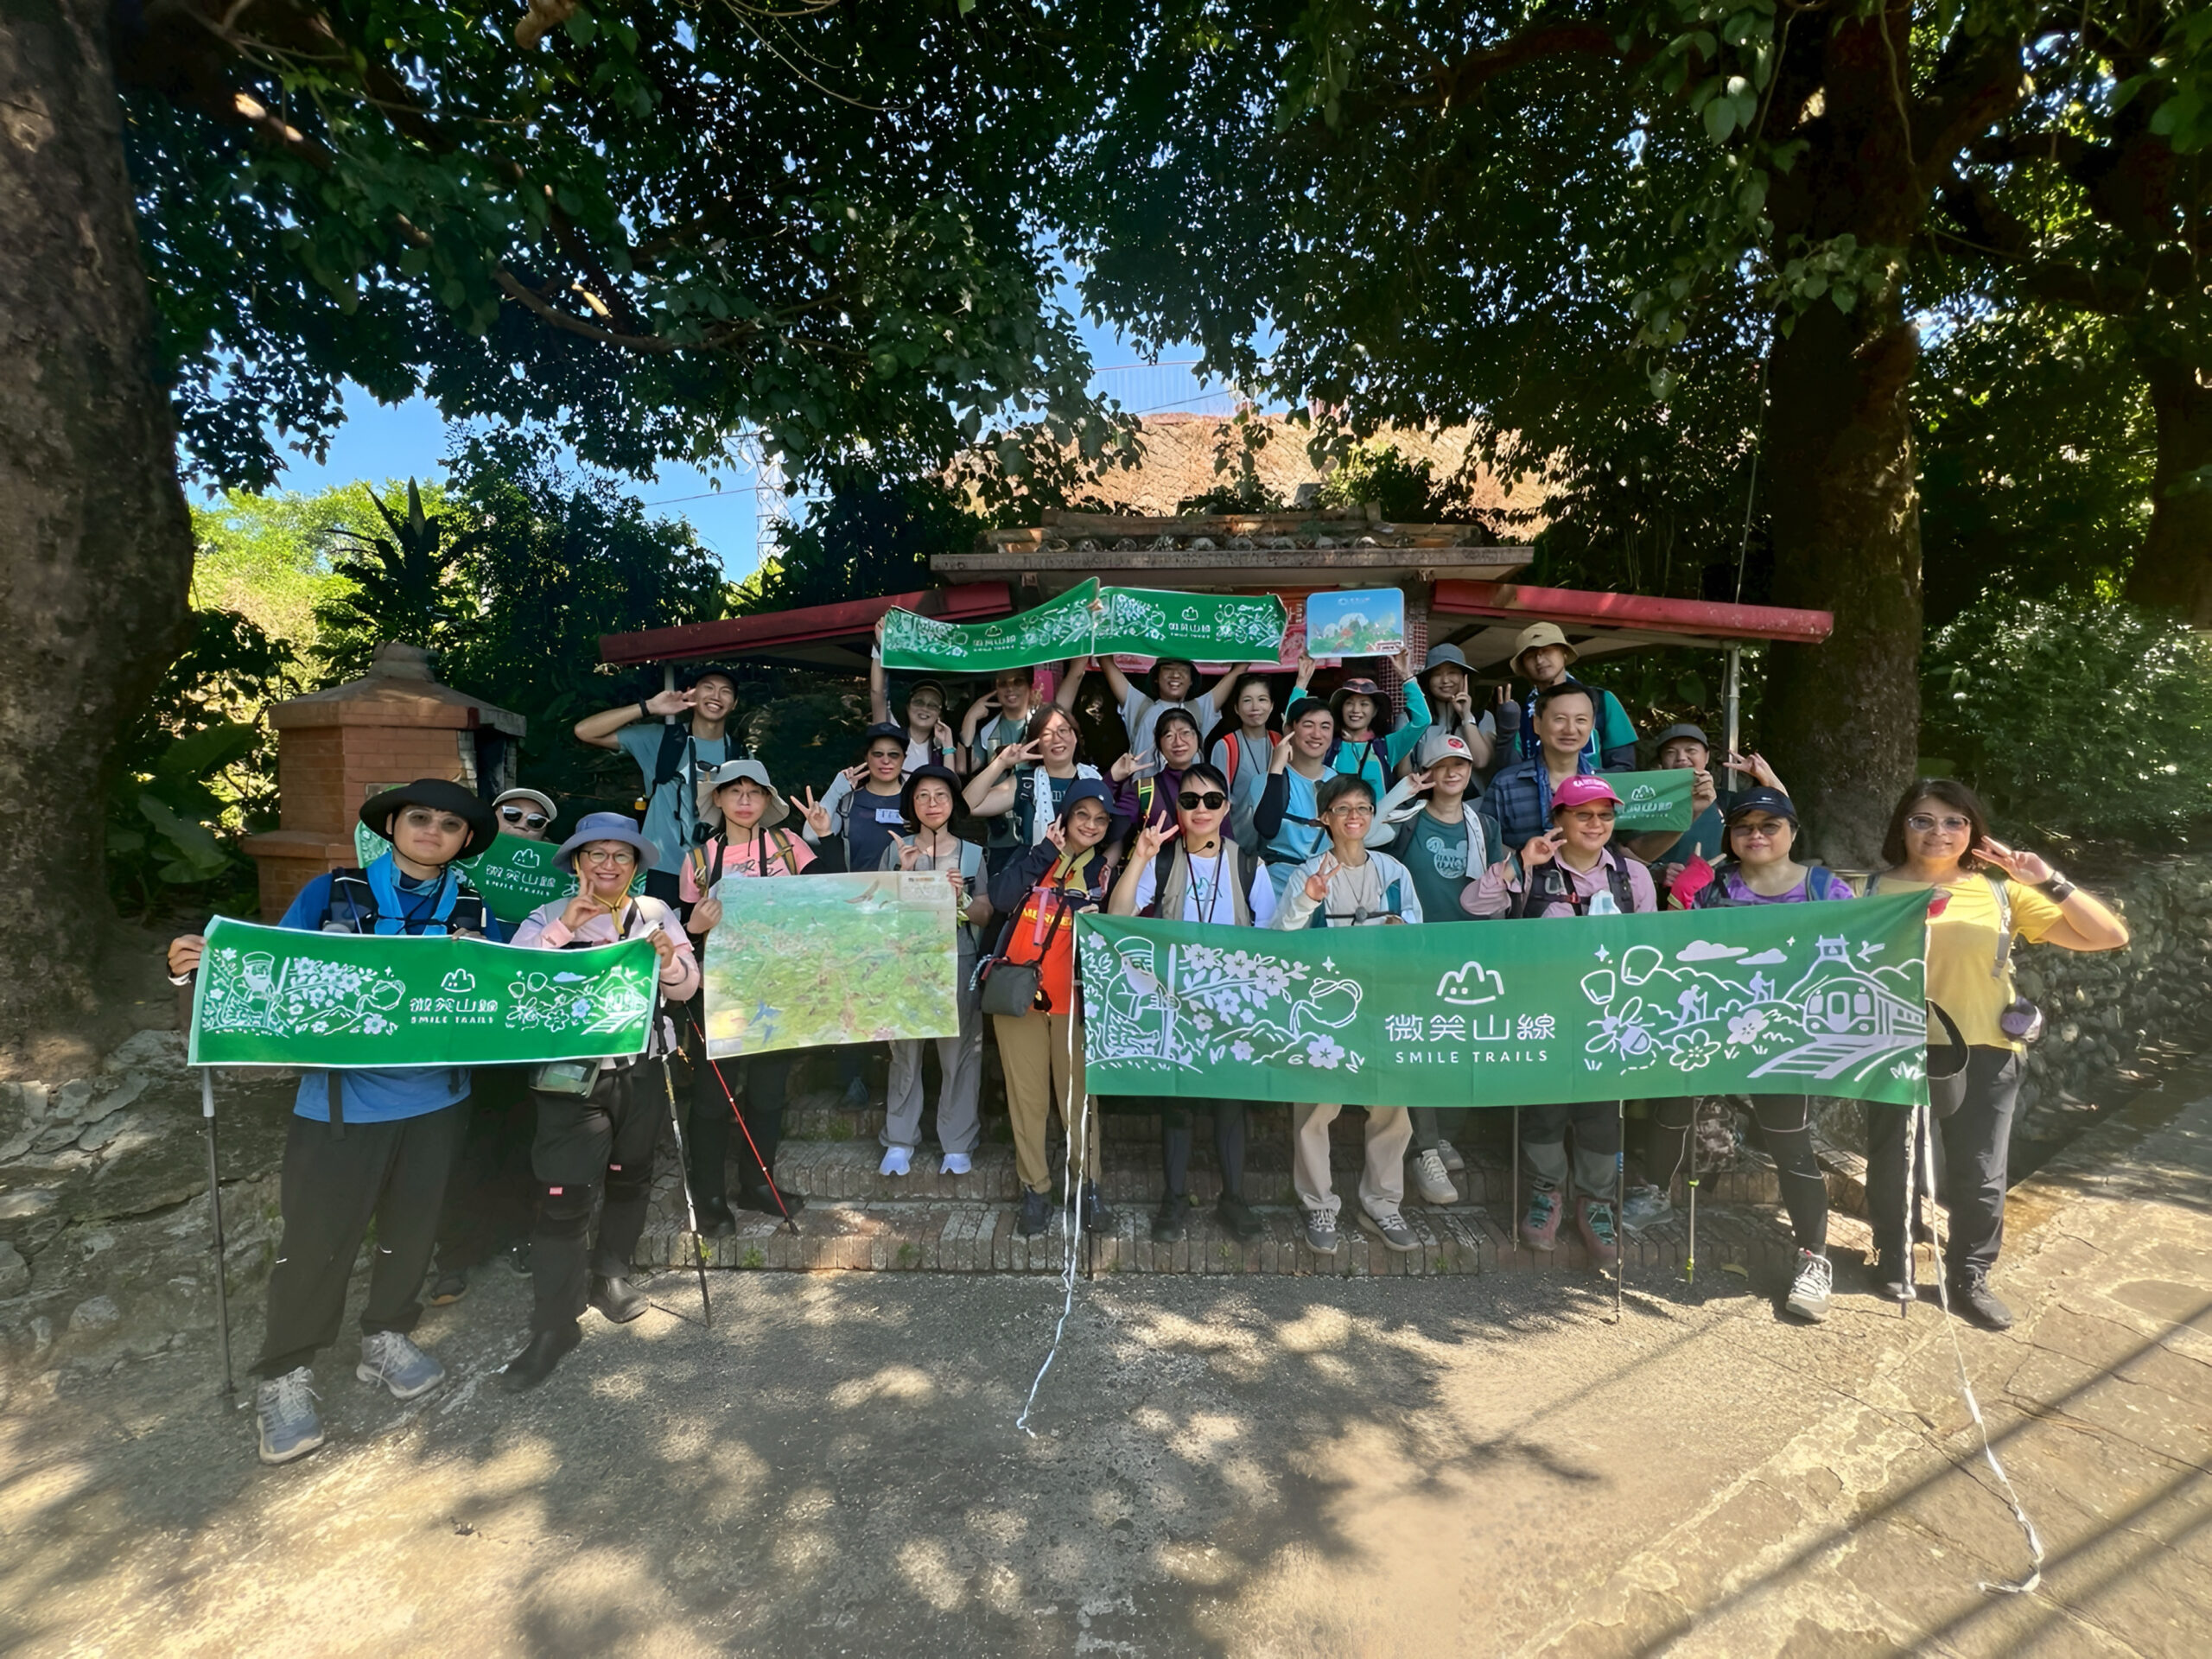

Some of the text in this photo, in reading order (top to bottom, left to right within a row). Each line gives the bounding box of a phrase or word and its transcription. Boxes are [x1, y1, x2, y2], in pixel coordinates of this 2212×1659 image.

[1385, 1013, 1556, 1042] 微笑山線
[1395, 1050, 1548, 1064] SMILE TRAILS
